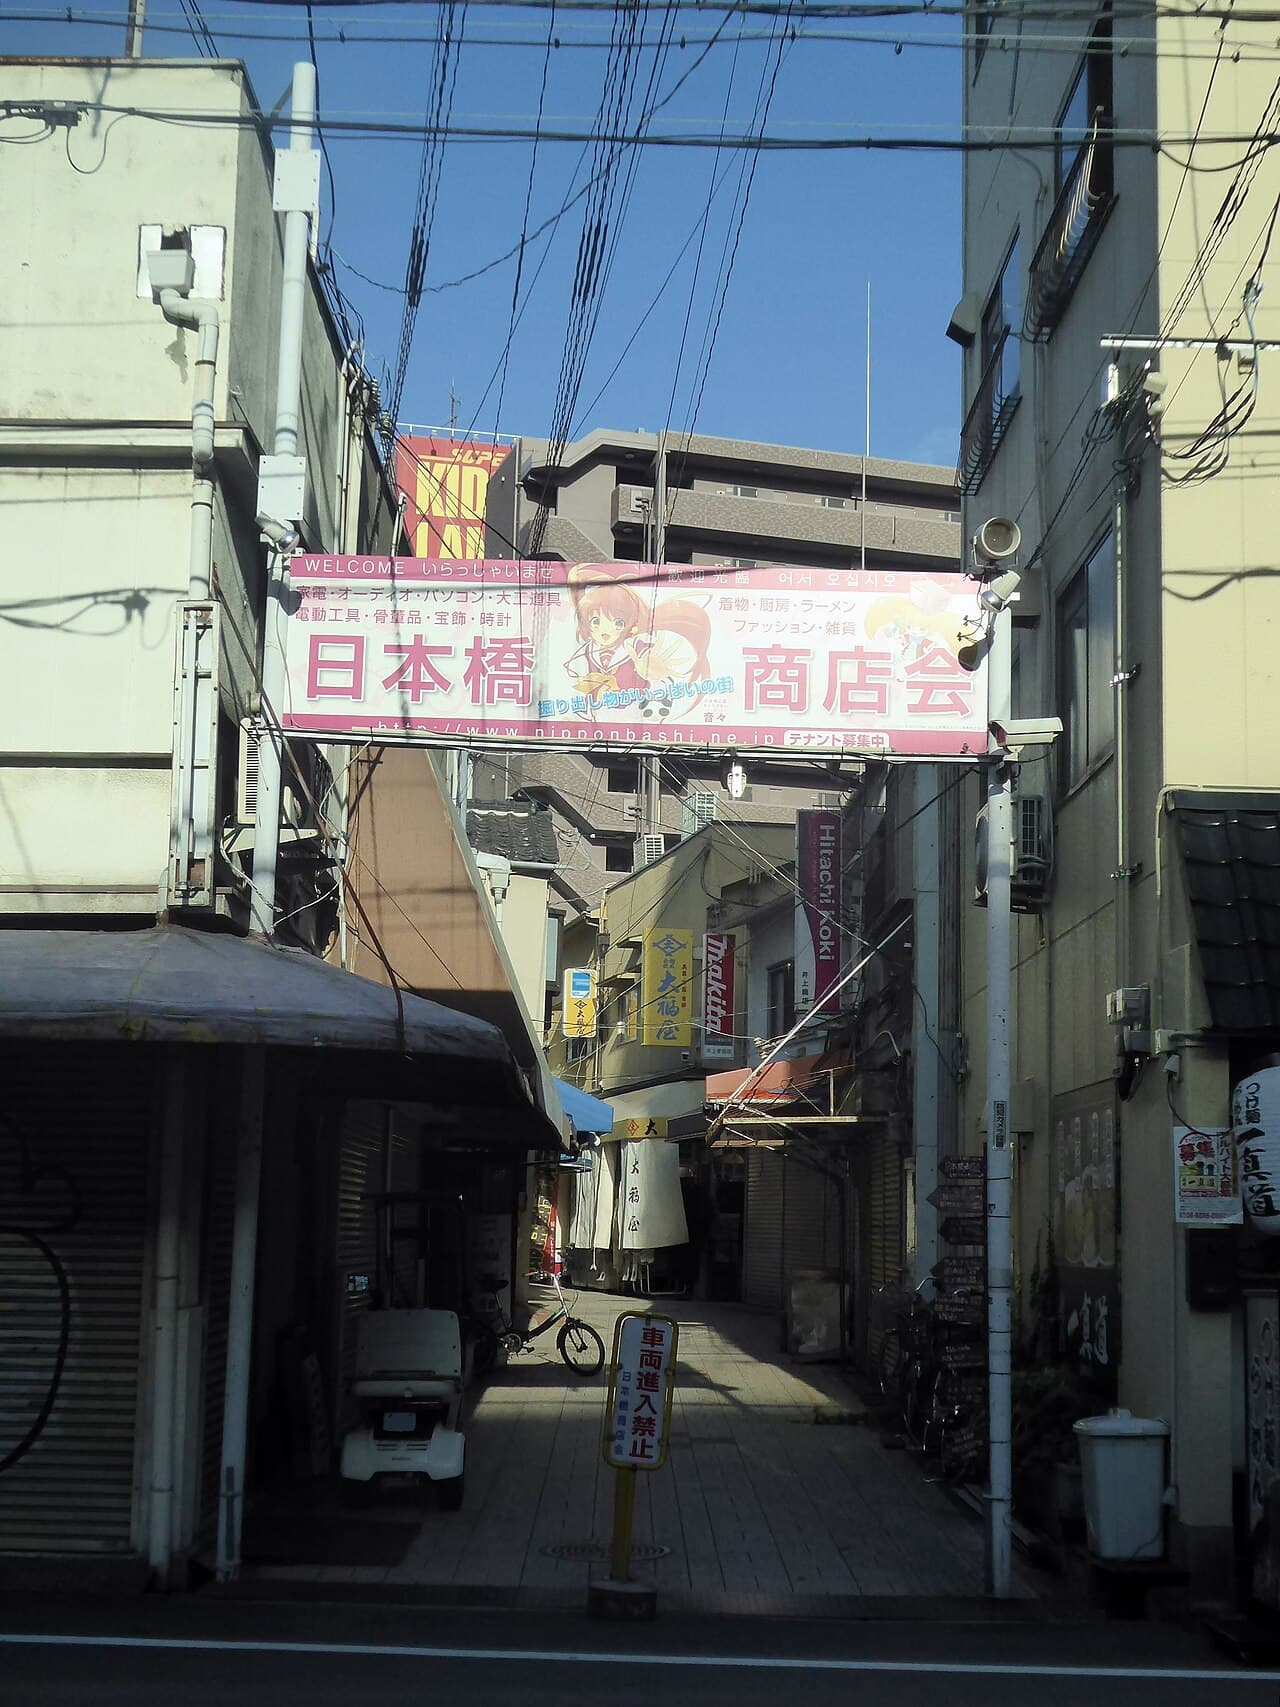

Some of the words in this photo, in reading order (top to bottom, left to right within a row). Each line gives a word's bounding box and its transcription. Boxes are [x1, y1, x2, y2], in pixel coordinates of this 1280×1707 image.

[416, 462, 490, 521] KID
[305, 559, 405, 575] WELCOME
[421, 562, 555, 580] いらっしゃいませ
[779, 571, 814, 586] 어서
[827, 573, 897, 588] 오십시오
[306, 633, 535, 706] 日本橋
[742, 644, 974, 717] 商店会
[537, 675, 734, 717] 掘り出し物がいっぱいの街
[378, 721, 774, 746] htt://wwwnipponbashi.ne.jp
[788, 732, 886, 748] テナント募集中
[818, 823, 835, 905] Hitachi
[818, 911, 835, 962] Koki
[645, 1119, 659, 1136] 大
[629, 1327, 665, 1459] 車両進入禁止
